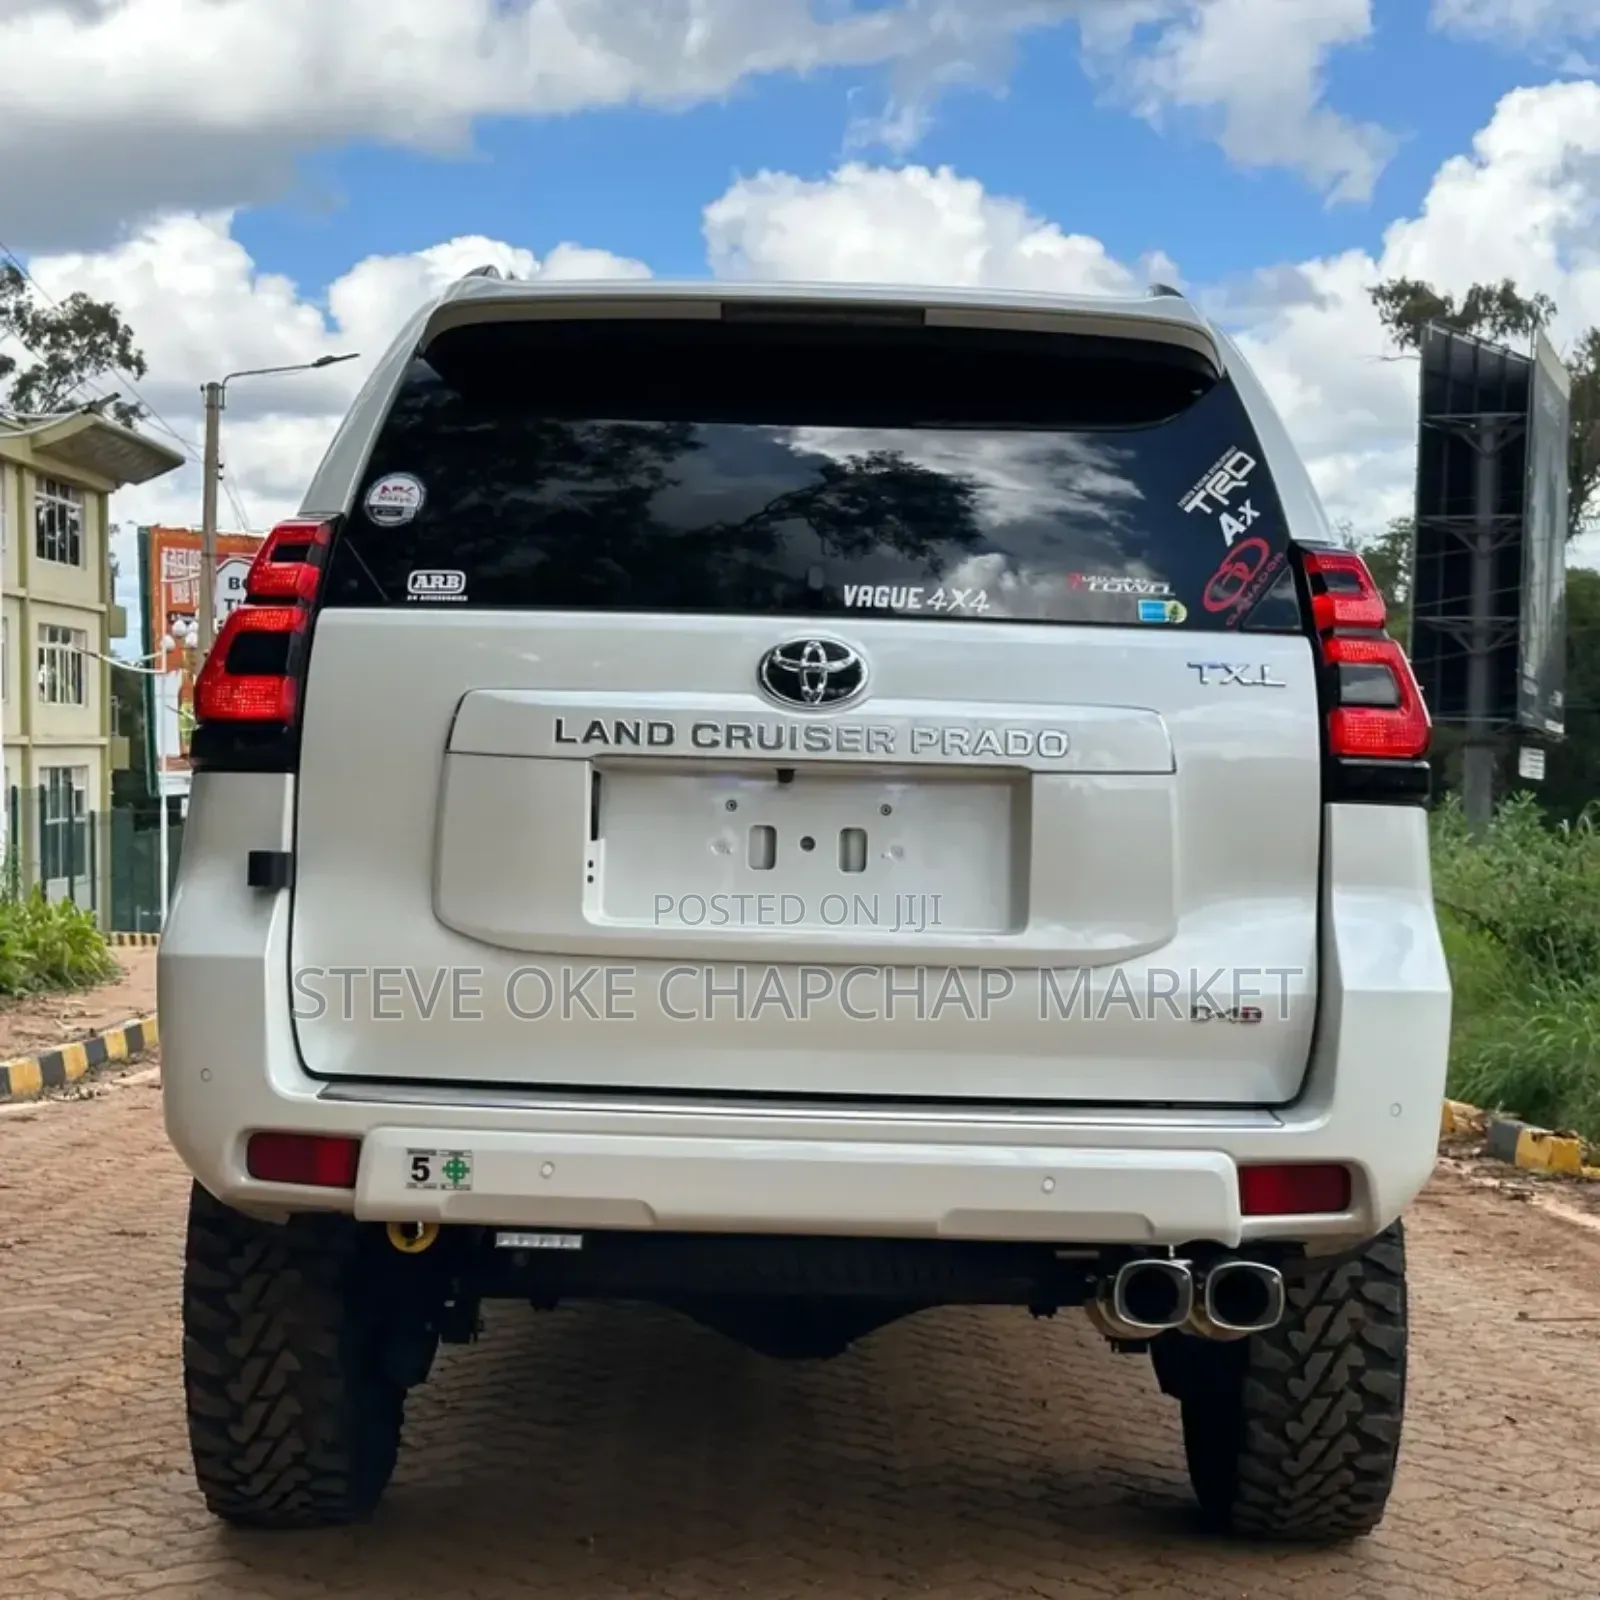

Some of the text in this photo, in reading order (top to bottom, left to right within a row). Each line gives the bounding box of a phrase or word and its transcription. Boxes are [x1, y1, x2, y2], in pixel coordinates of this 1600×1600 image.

[1184, 451, 1257, 514] TRD
[413, 575, 460, 589] ARB
[844, 585, 990, 613] VAGUE 4X4
[1186, 662, 1286, 687] TXL
[555, 718, 1069, 758] LAND CRUISER PRADO
[411, 1157, 430, 1182] 5
